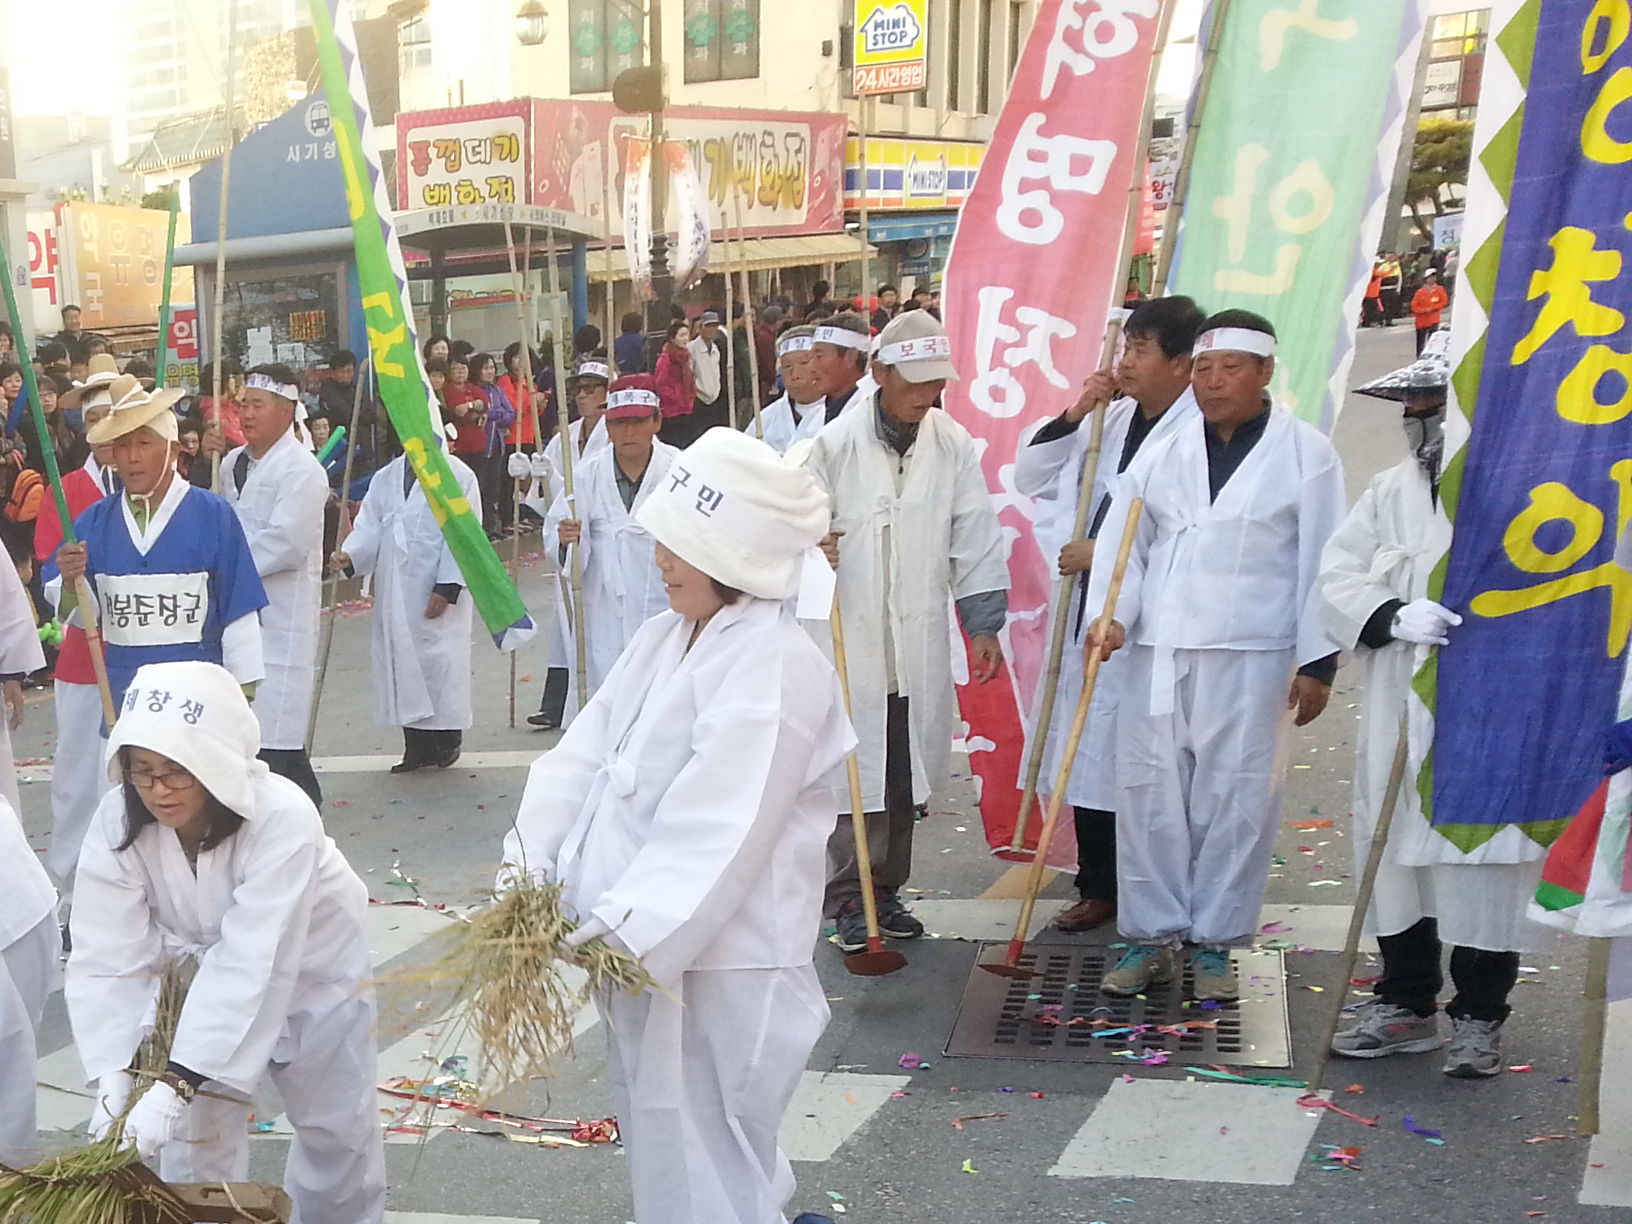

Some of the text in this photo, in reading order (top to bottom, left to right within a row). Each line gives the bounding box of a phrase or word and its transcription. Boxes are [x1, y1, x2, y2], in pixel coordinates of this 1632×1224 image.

[873, 16, 907, 32] MINI
[871, 31, 909, 47] STOP
[408, 133, 520, 177] 폰껍데기
